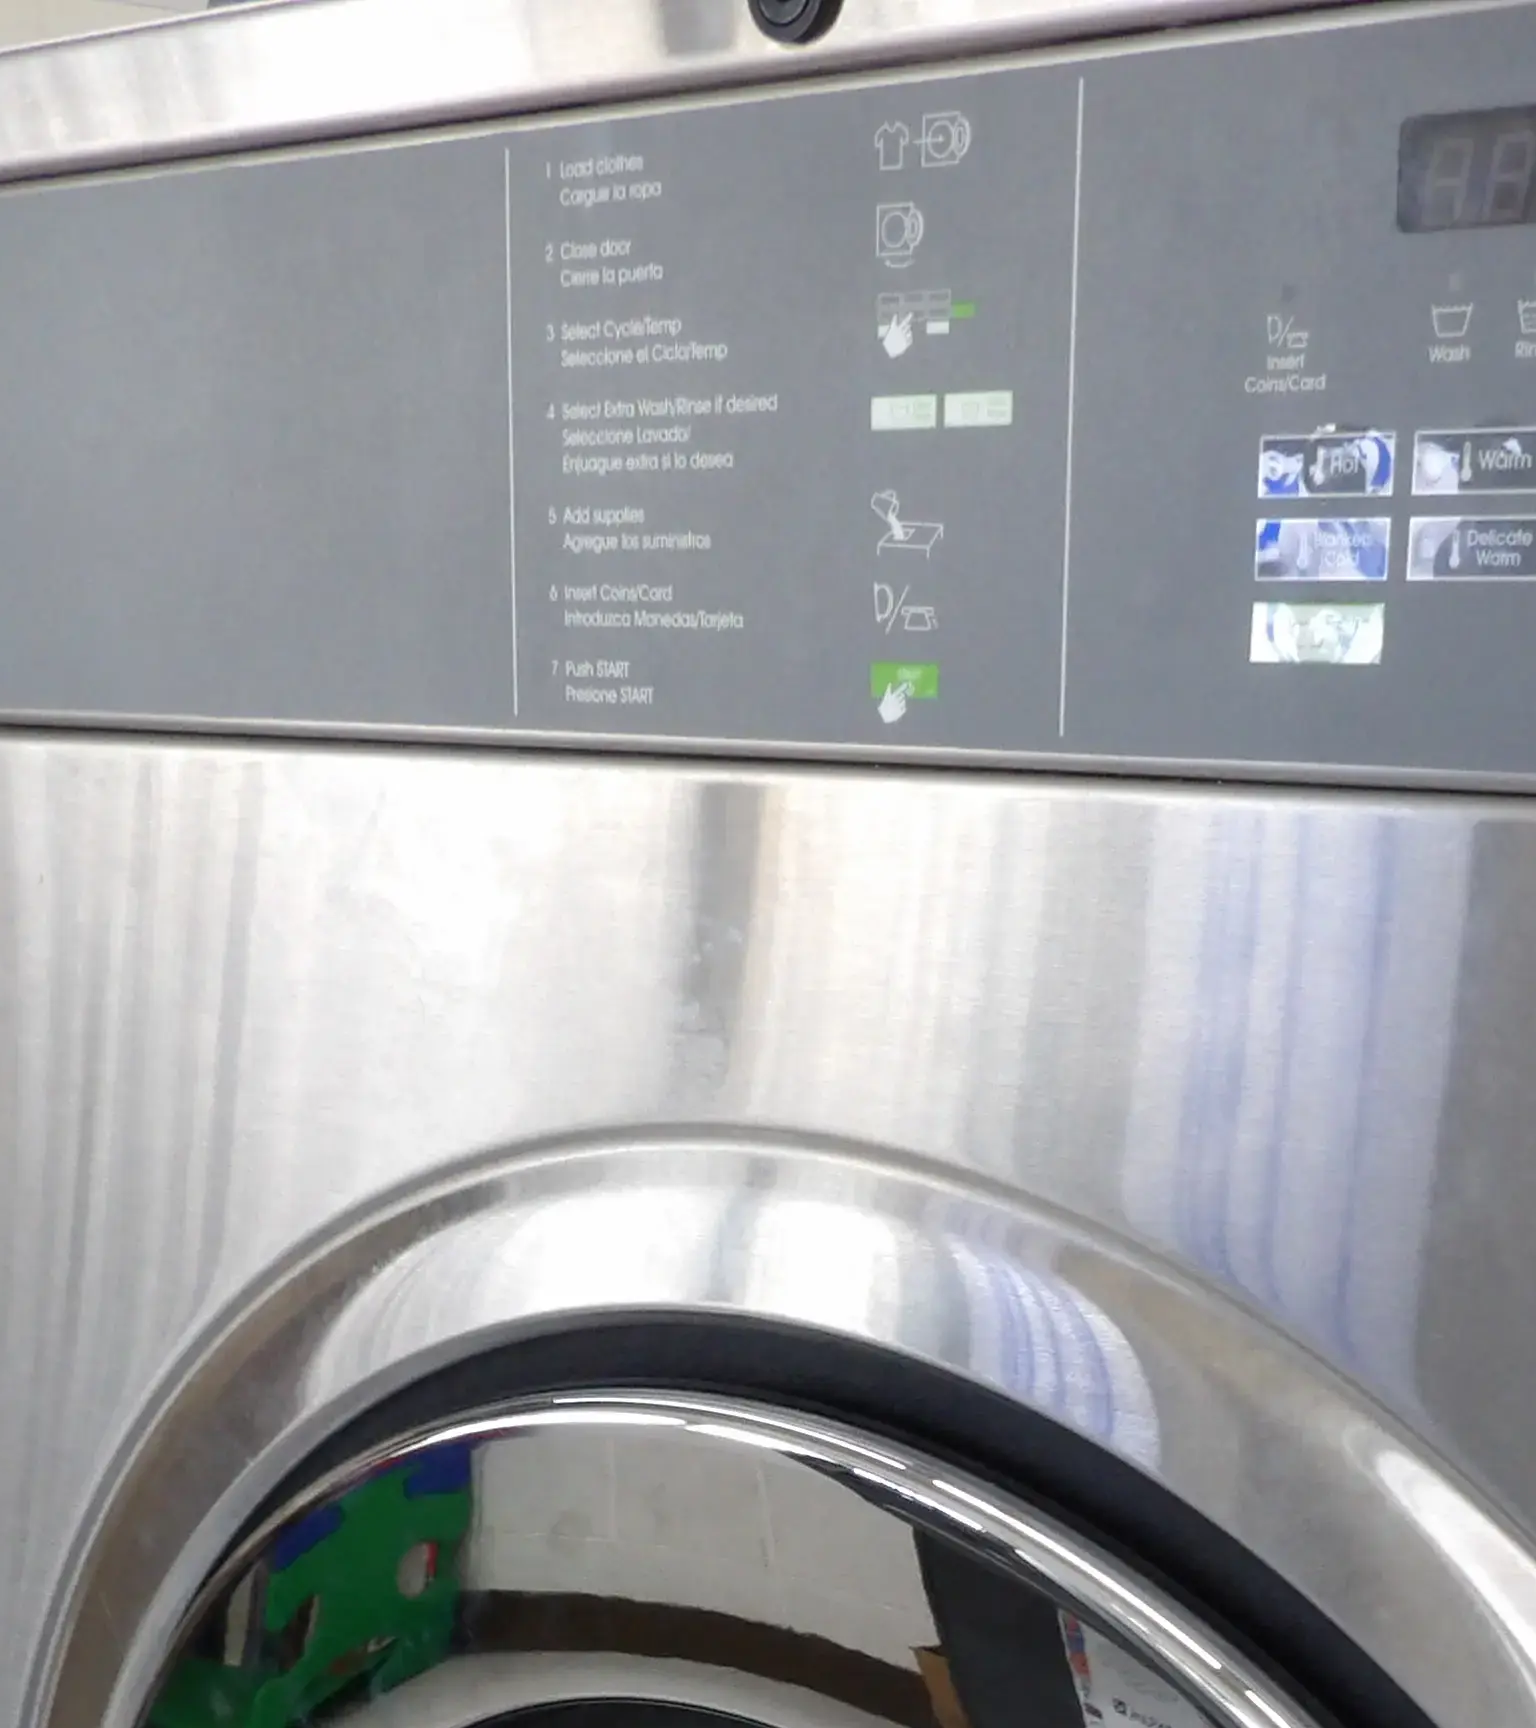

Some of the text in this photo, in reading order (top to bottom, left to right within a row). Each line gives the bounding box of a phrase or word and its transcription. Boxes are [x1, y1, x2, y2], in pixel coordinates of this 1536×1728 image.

[560, 157, 594, 180] Load
[596, 155, 644, 175] clothes
[629, 181, 662, 201] ropa
[545, 239, 631, 263] 2 Close door
[602, 266, 615, 284] la
[618, 263, 663, 287] puerta
[546, 324, 555, 342] 3
[561, 321, 600, 340] Select
[561, 347, 633, 367] Seleccione
[636, 346, 649, 363] el
[1267, 353, 1305, 371] Insert
[1428, 345, 1472, 363] Wash
[1244, 373, 1326, 394] Coins/Card
[546, 403, 555, 420] 4
[562, 400, 601, 420] Select
[604, 400, 635, 418] Extra
[726, 394, 778, 414] desired
[562, 426, 633, 447] Seleccione
[562, 453, 623, 476] Enjuague
[626, 453, 658, 471] extra
[674, 452, 686, 469] lo
[690, 451, 733, 469] desea
[1478, 450, 1533, 470] Warm
[548, 506, 644, 527] 5 Add supplies
[563, 531, 712, 554] Agregue los suministros
[1467, 528, 1534, 548] Delicate
[1476, 549, 1522, 568] Warm
[549, 584, 673, 602] 6 Insert Coins/Card
[564, 609, 744, 632] Introduzca Monedas/Tarjeta
[551, 659, 630, 679] 7 Push START
[565, 684, 654, 705] Presione START
